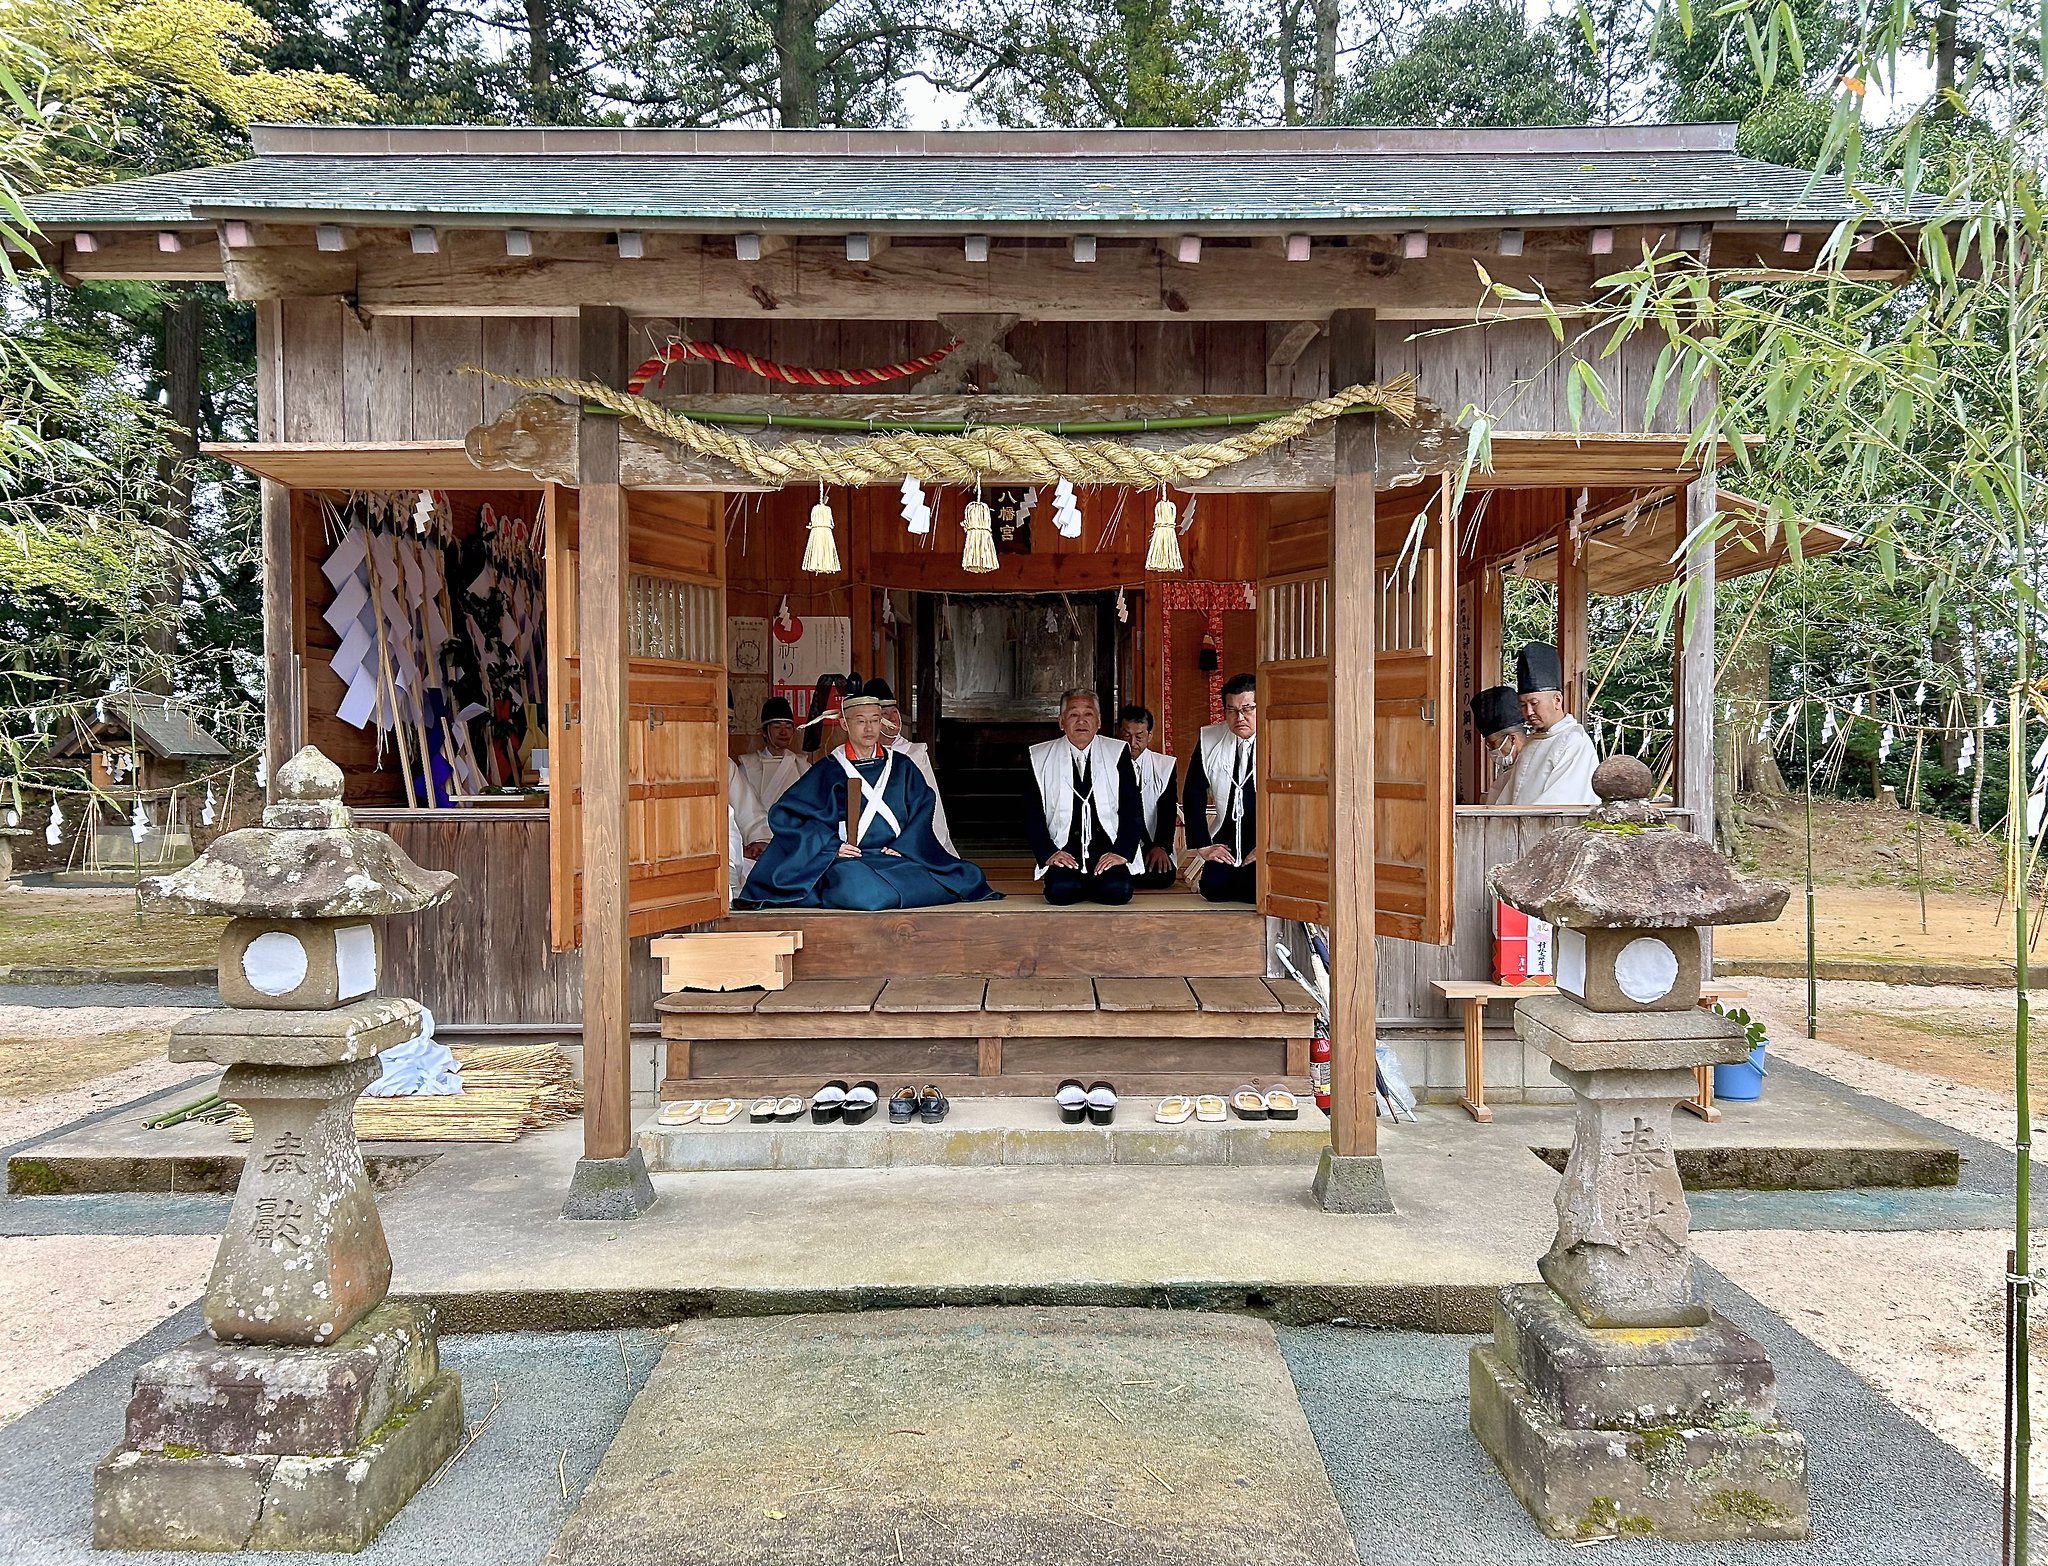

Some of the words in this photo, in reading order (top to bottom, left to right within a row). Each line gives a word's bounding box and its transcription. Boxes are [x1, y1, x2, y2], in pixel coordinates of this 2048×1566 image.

[998, 490, 1017, 541] 八幡宮
[778, 642, 799, 678] 祈り
